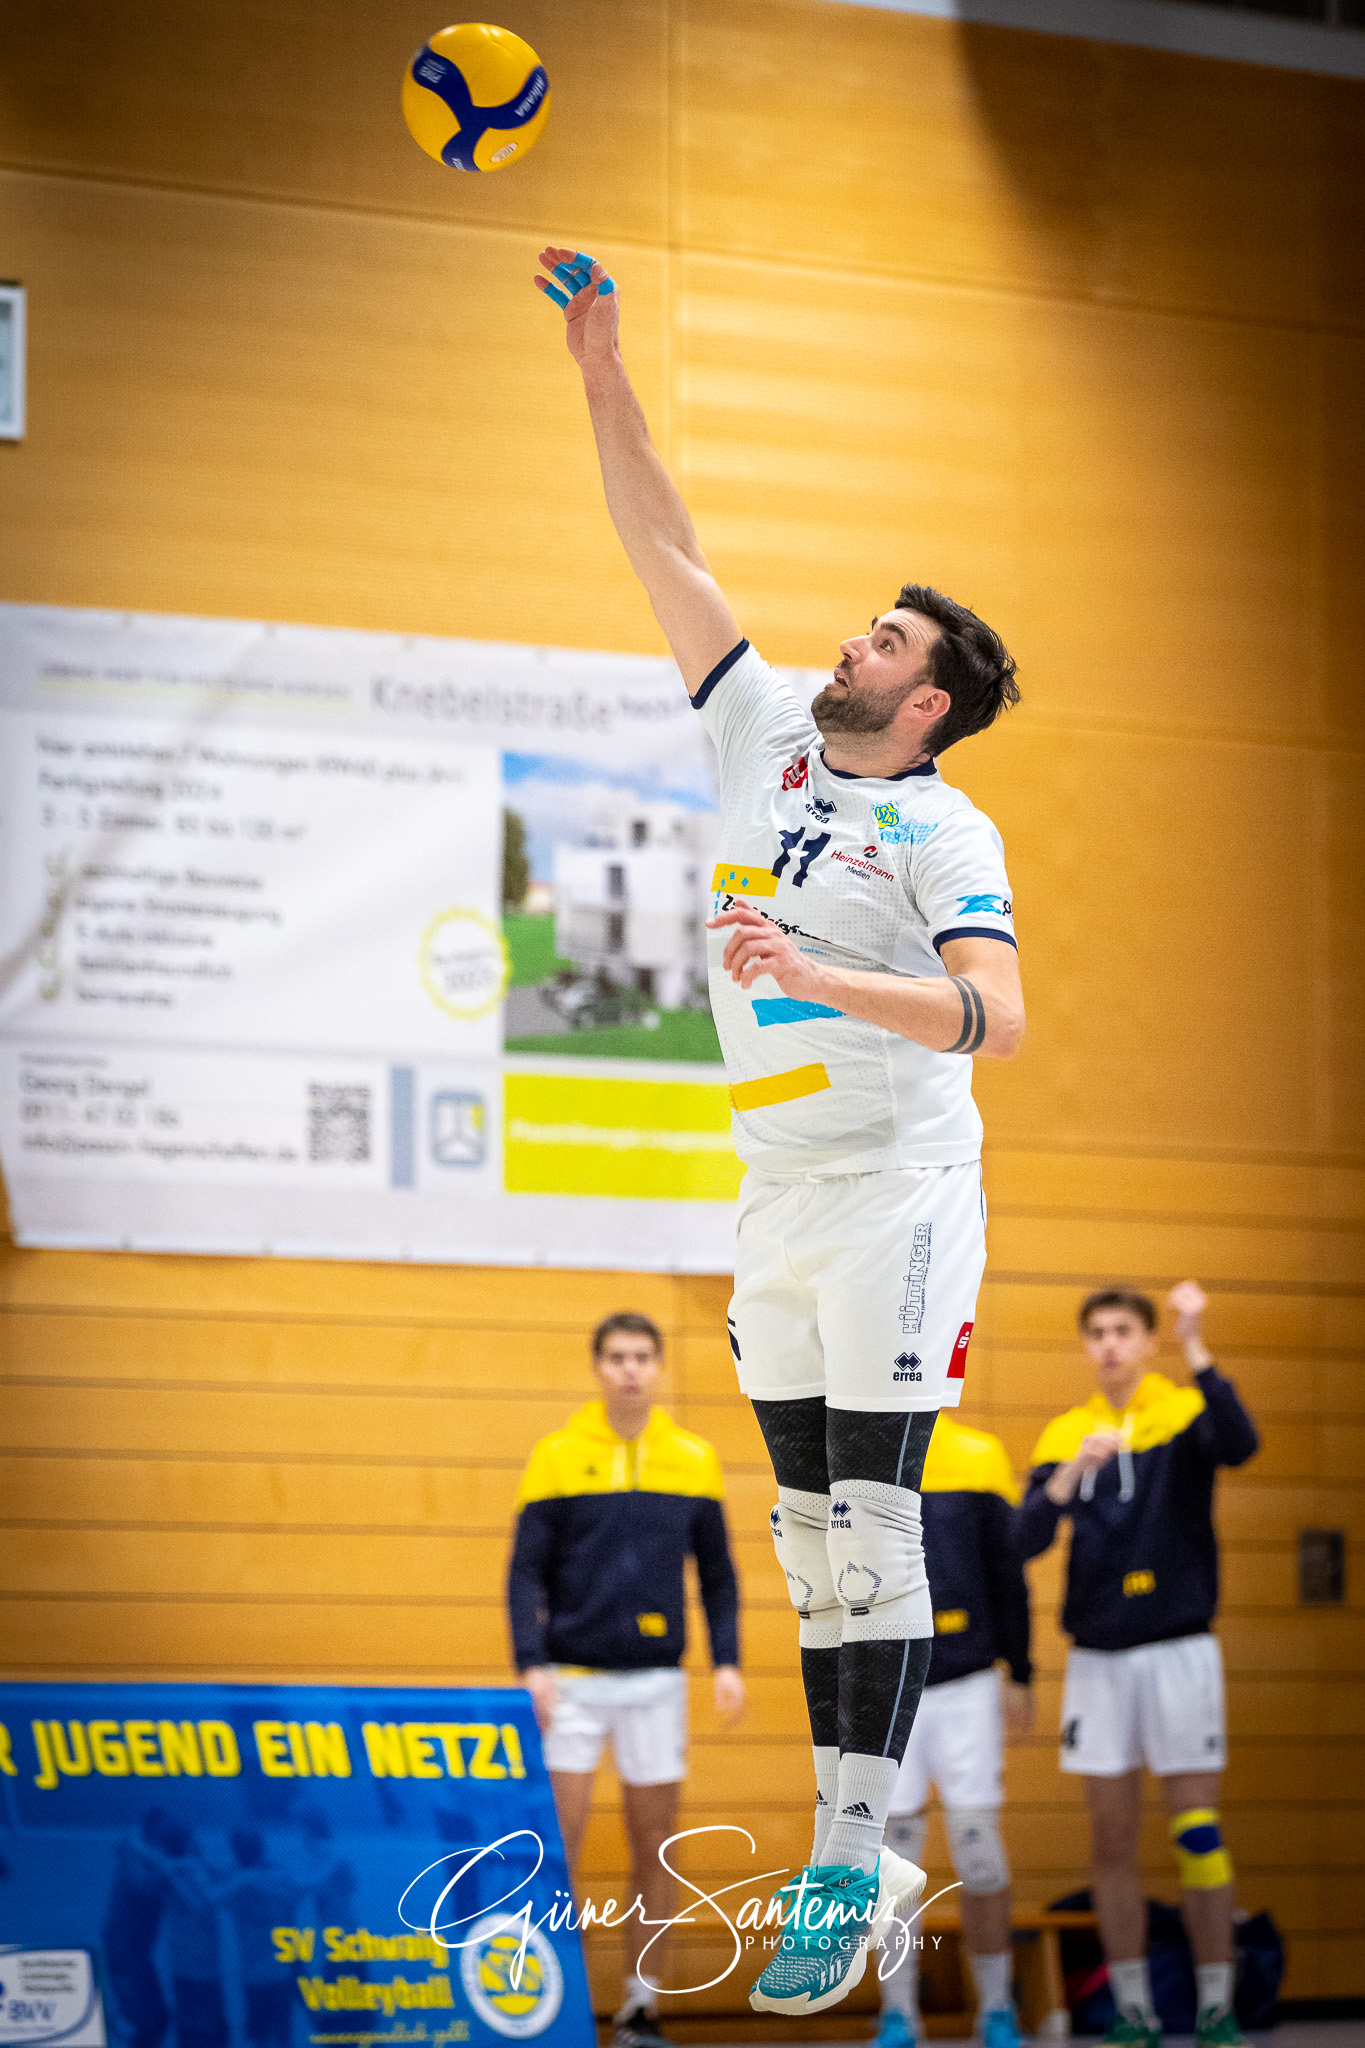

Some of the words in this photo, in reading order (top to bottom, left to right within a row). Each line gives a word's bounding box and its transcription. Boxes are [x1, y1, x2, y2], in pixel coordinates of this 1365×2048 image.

[771, 826, 831, 888] 11
[831, 850, 894, 882] Heinzelmann
[845, 865, 871, 881] Medien
[32, 1719, 241, 1790] JUGEND
[253, 1720, 351, 1778] EIN
[362, 1722, 526, 1779] NETZ!
[842, 1808, 874, 1820] adidas
[271, 1926, 315, 1962] SV
[323, 1926, 449, 1968] Schwaig
[297, 1976, 455, 2016] Volleyball
